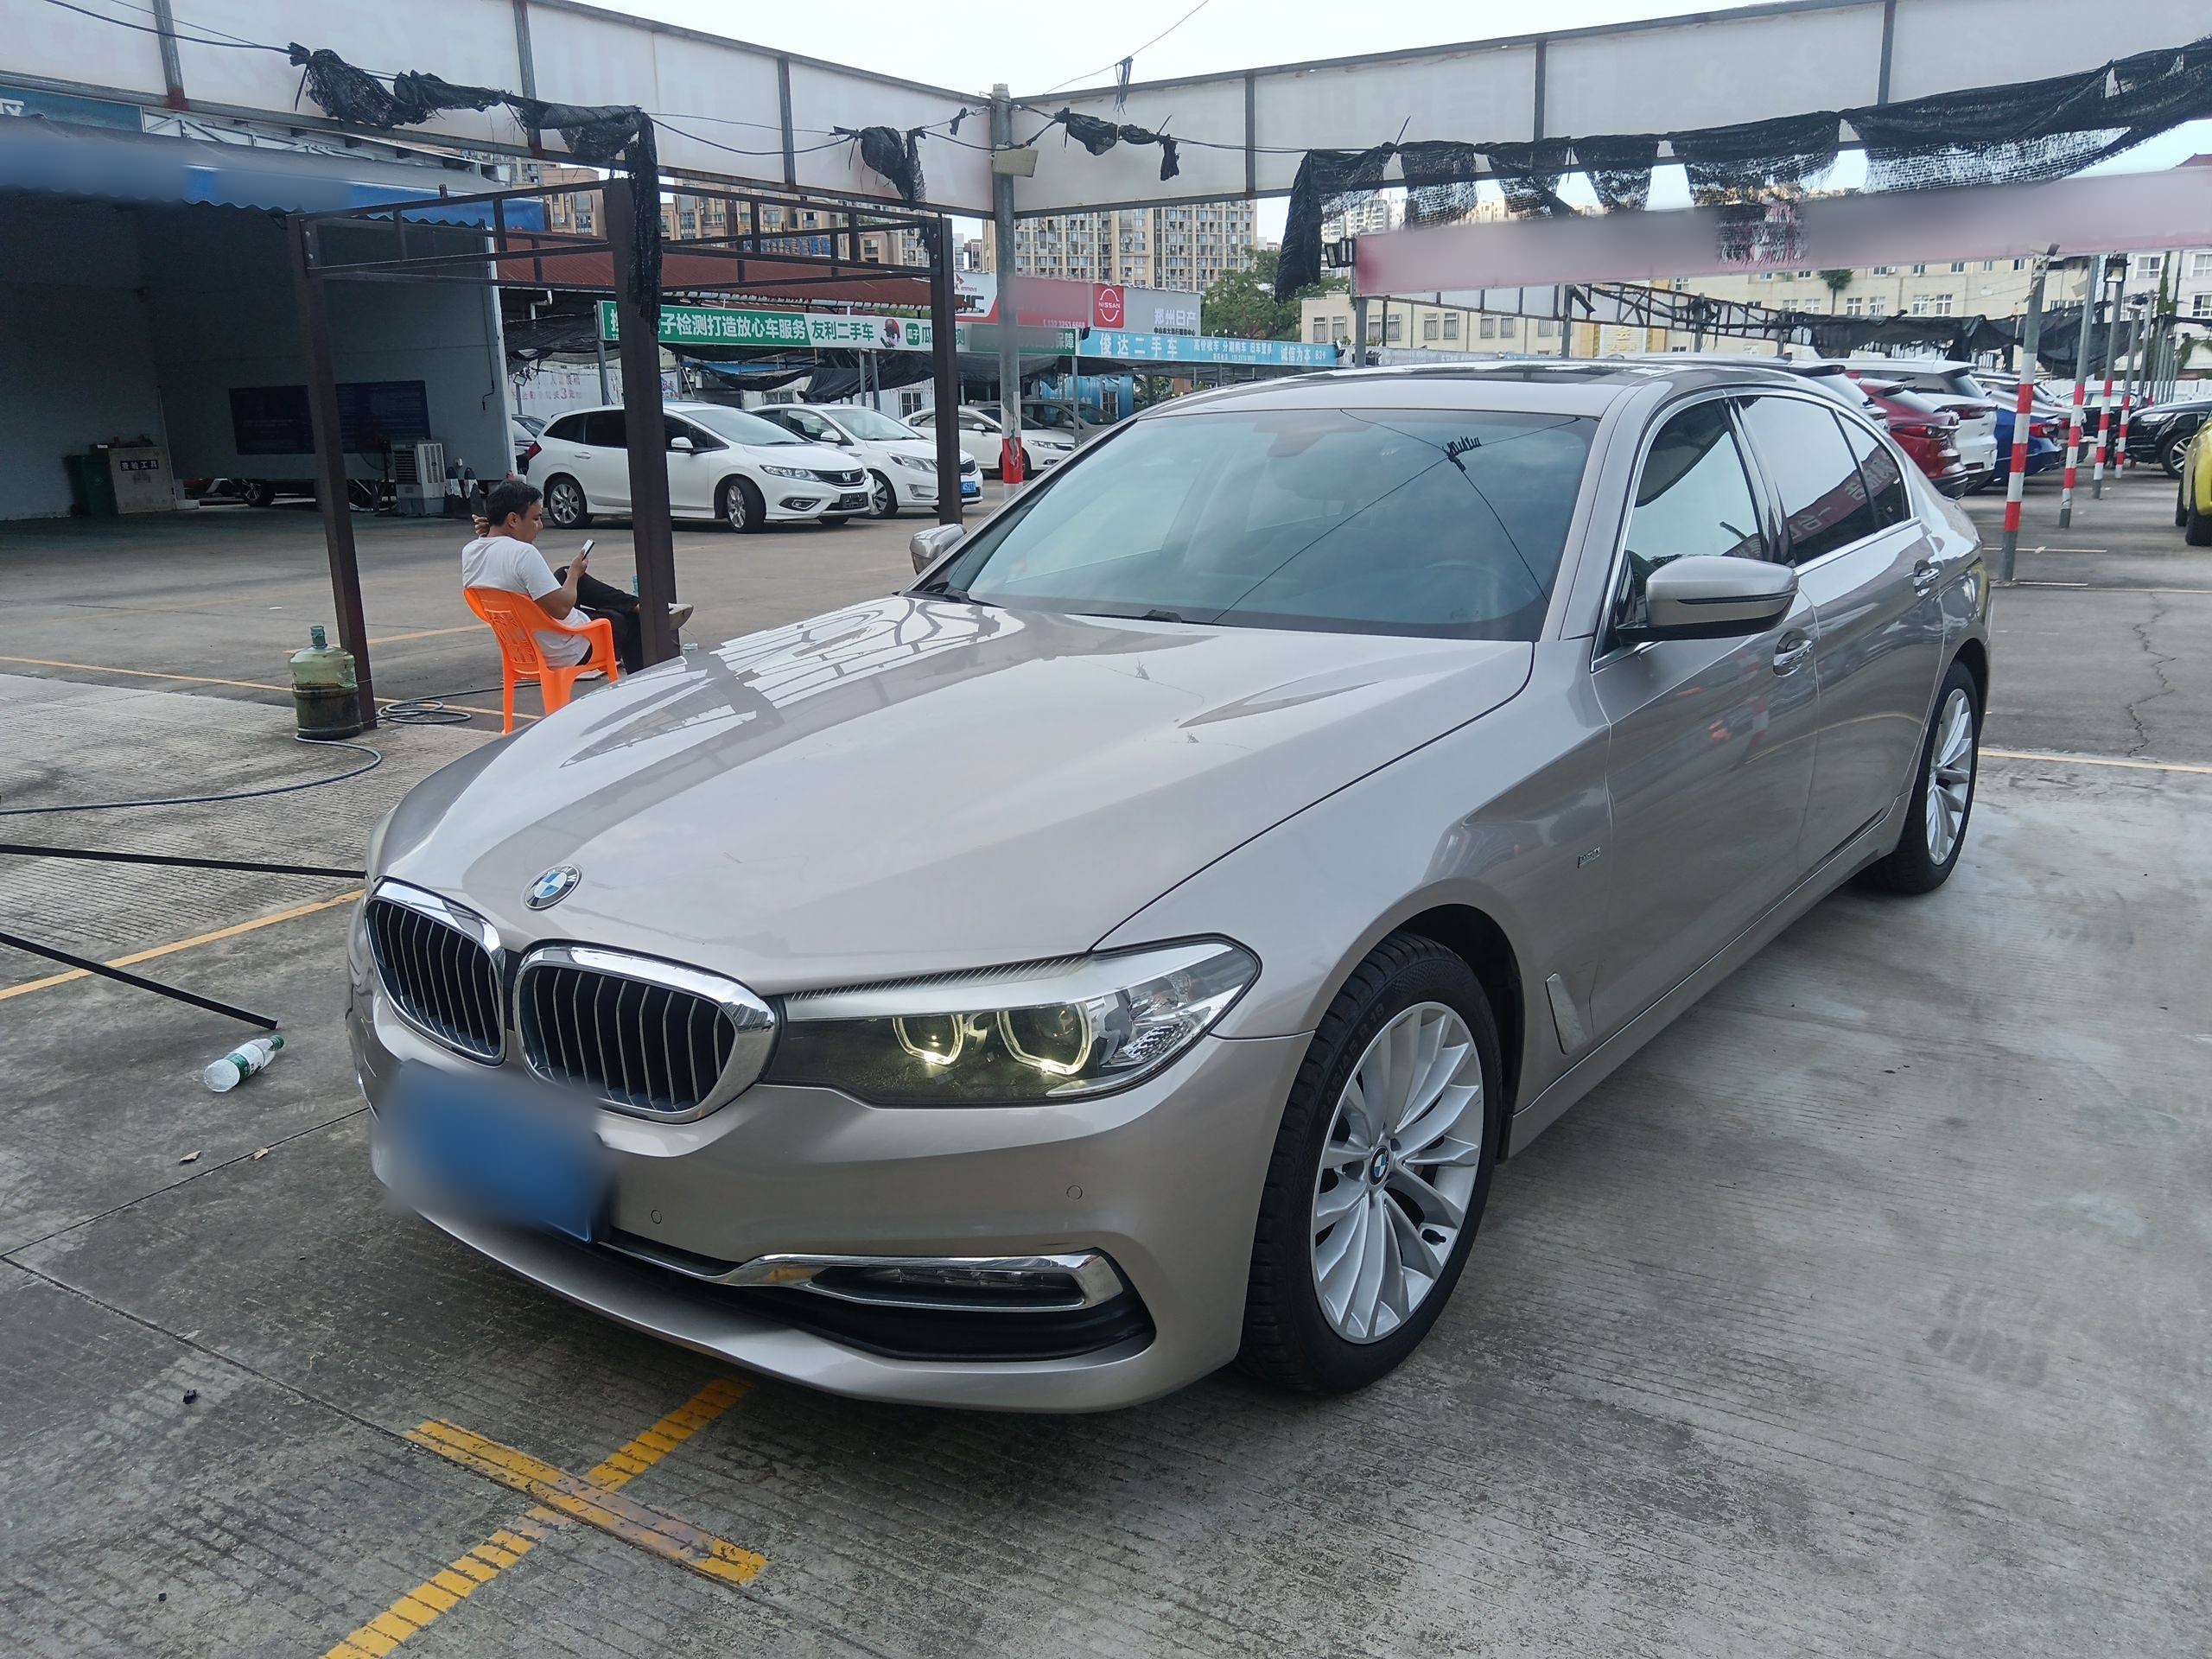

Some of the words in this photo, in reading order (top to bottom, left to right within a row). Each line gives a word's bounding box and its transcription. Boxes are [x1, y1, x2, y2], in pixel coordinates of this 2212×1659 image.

[658, 312, 806, 340] 子检测打造放心车服务
[1154, 308, 1197, 327] 郑州日产
[811, 320, 874, 341] 友利二手车
[1100, 333, 1178, 359] 俊达二手车
[1281, 345, 1311, 363] 诚信为本
